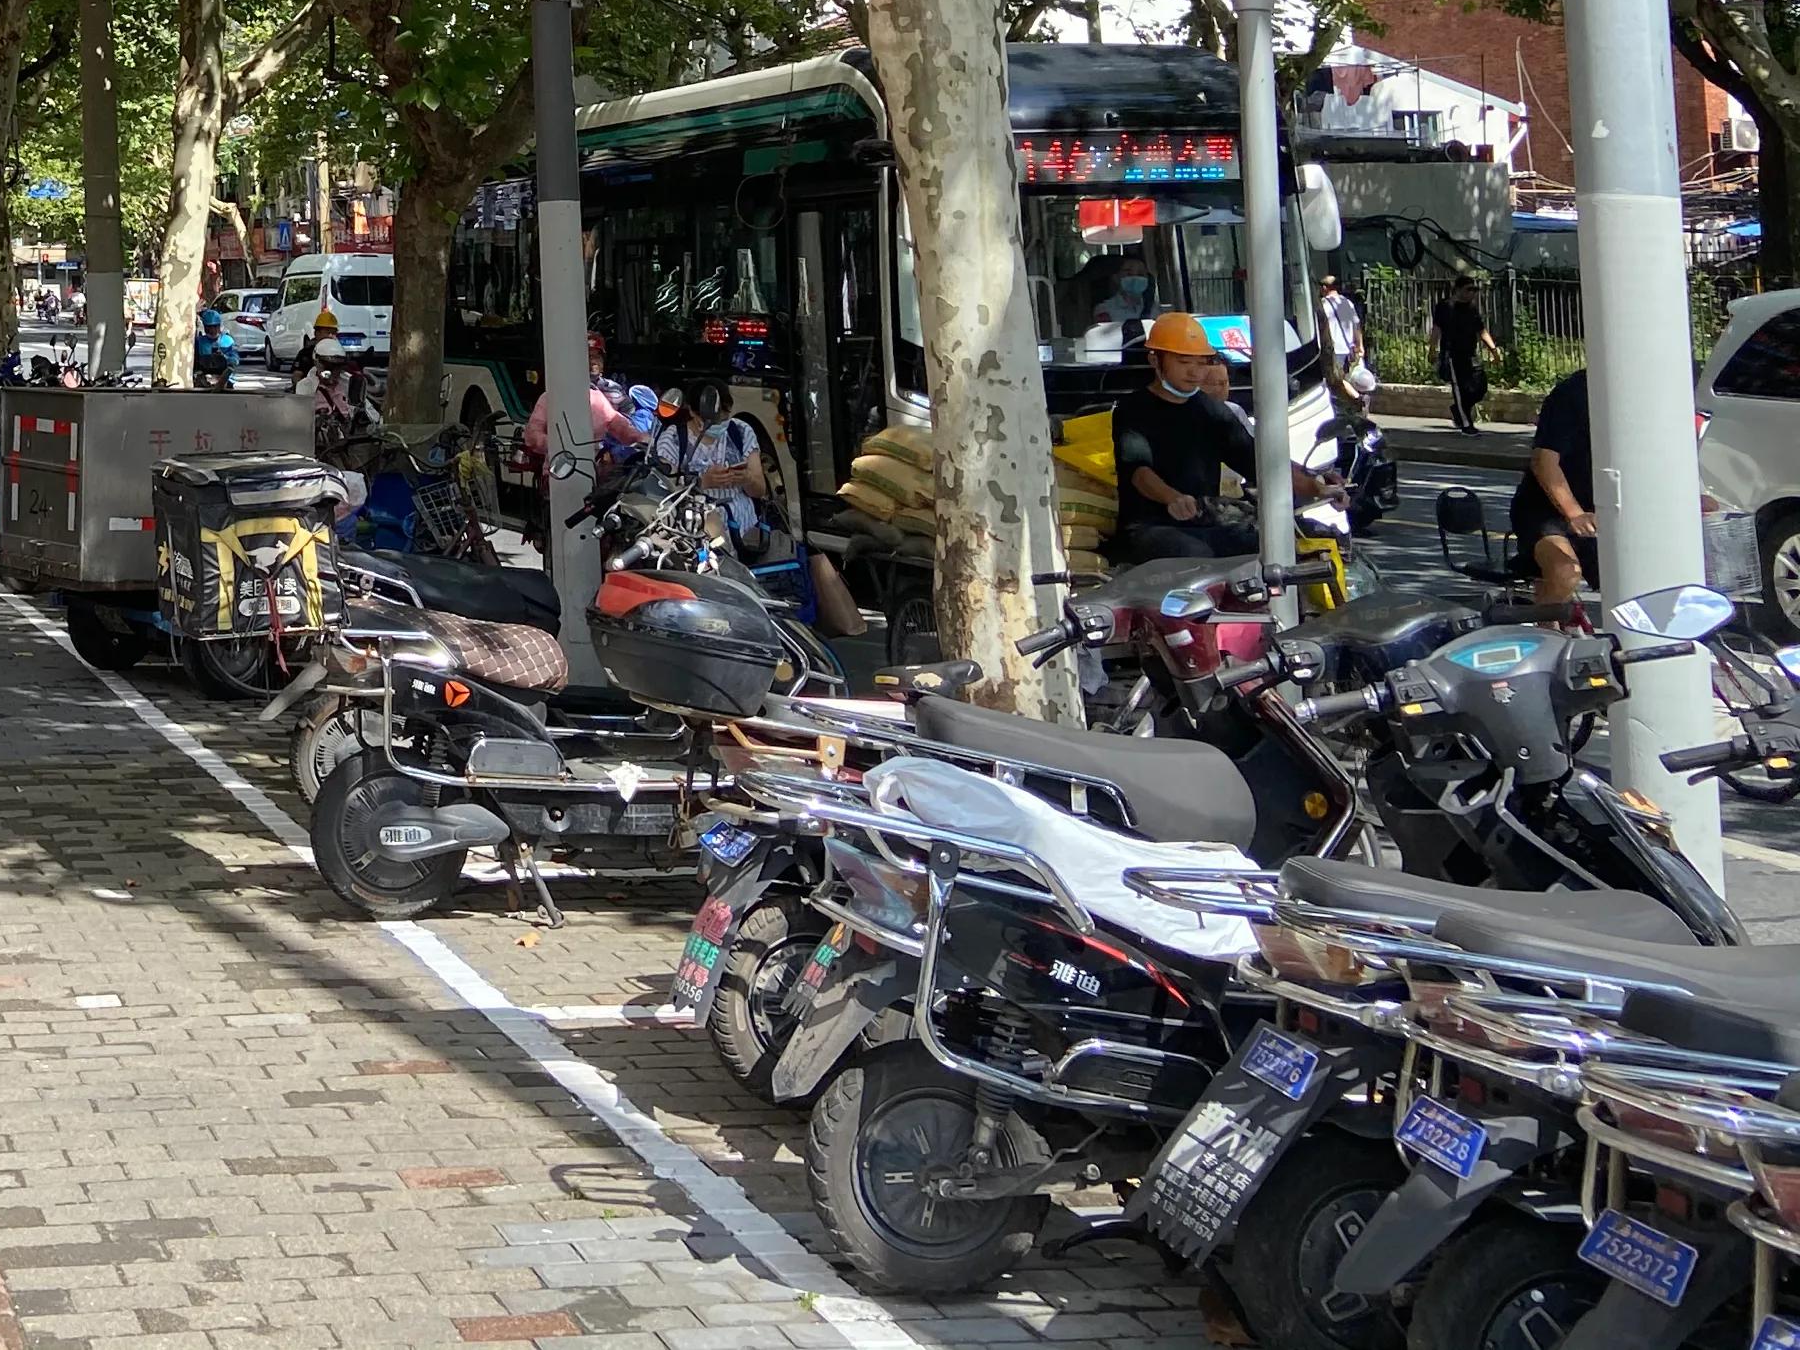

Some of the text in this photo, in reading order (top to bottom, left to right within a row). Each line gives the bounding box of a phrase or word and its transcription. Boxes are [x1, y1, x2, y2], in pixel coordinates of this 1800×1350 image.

[29, 489, 48, 516] 24
[239, 578, 298, 599] 美团外卖
[1049, 959, 1100, 997] 雅迪
[1406, 1114, 1469, 1160] 7132228
[1595, 1231, 1676, 1286] 7522372
